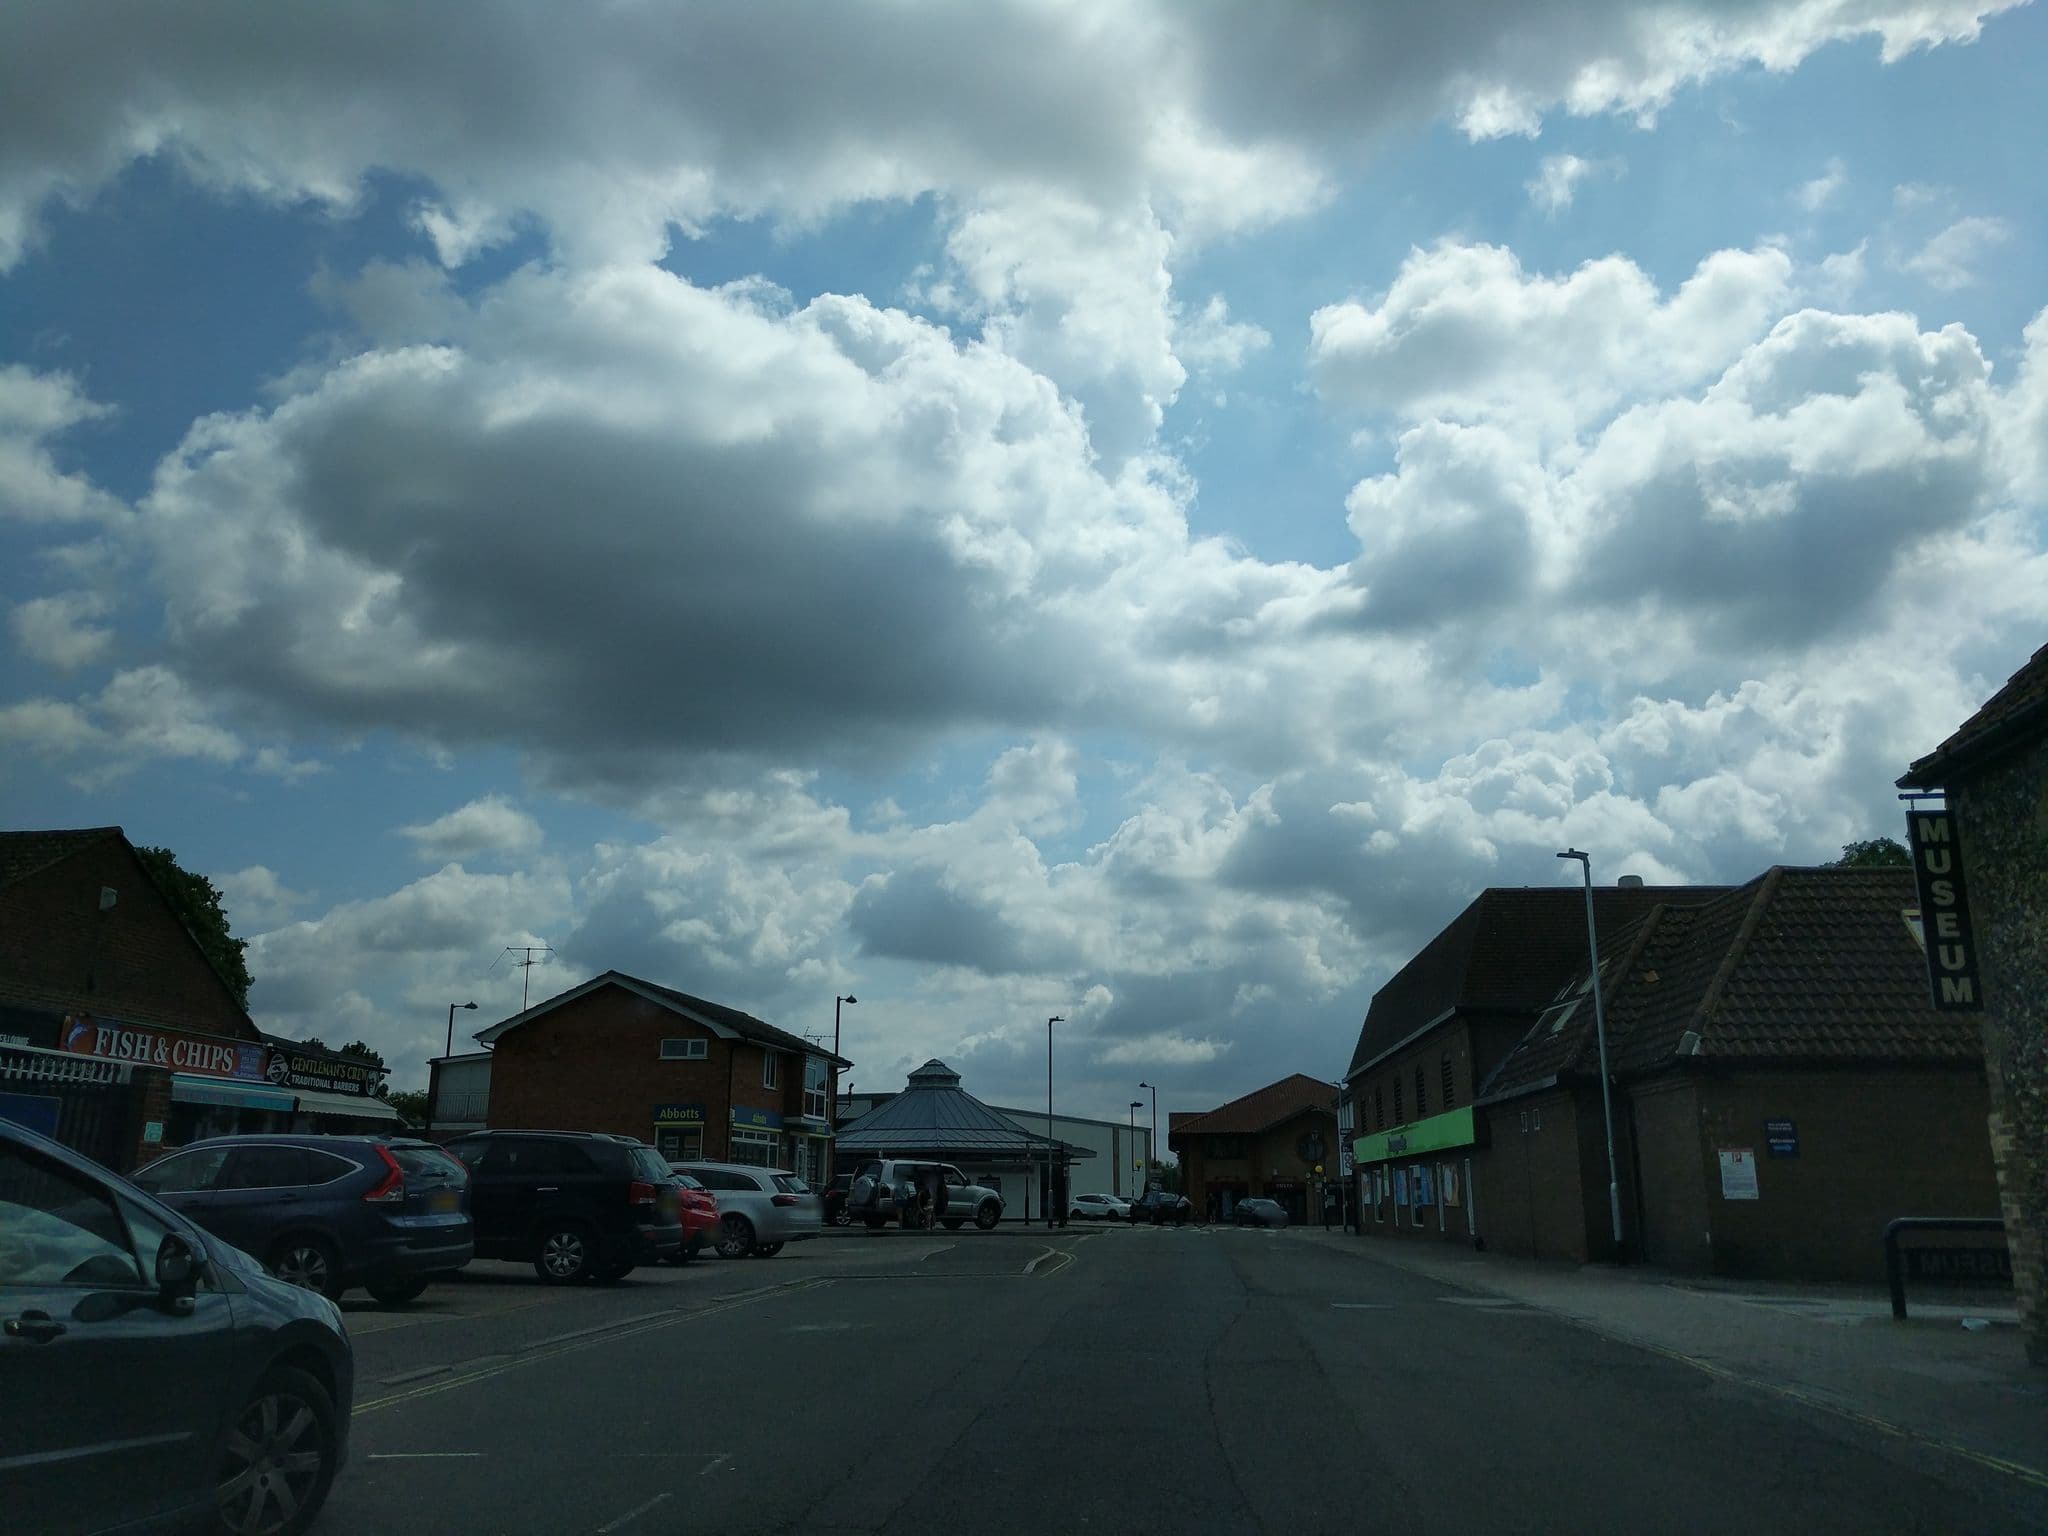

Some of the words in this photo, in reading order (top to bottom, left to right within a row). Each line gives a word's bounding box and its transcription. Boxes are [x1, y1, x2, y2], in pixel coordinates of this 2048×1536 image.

[1918, 817, 1974, 1004] MUSEUM
[93, 1026, 154, 1061] FISH
[153, 1036, 170, 1064] &
[172, 1039, 234, 1072] CHIPS
[291, 1055, 346, 1079] GENTLEMAN'S
[347, 1066, 369, 1082] CREW
[291, 1074, 331, 1089] TRADITIONAL
[333, 1080, 360, 1093] BARBERS
[659, 1107, 700, 1119] Abbotts
